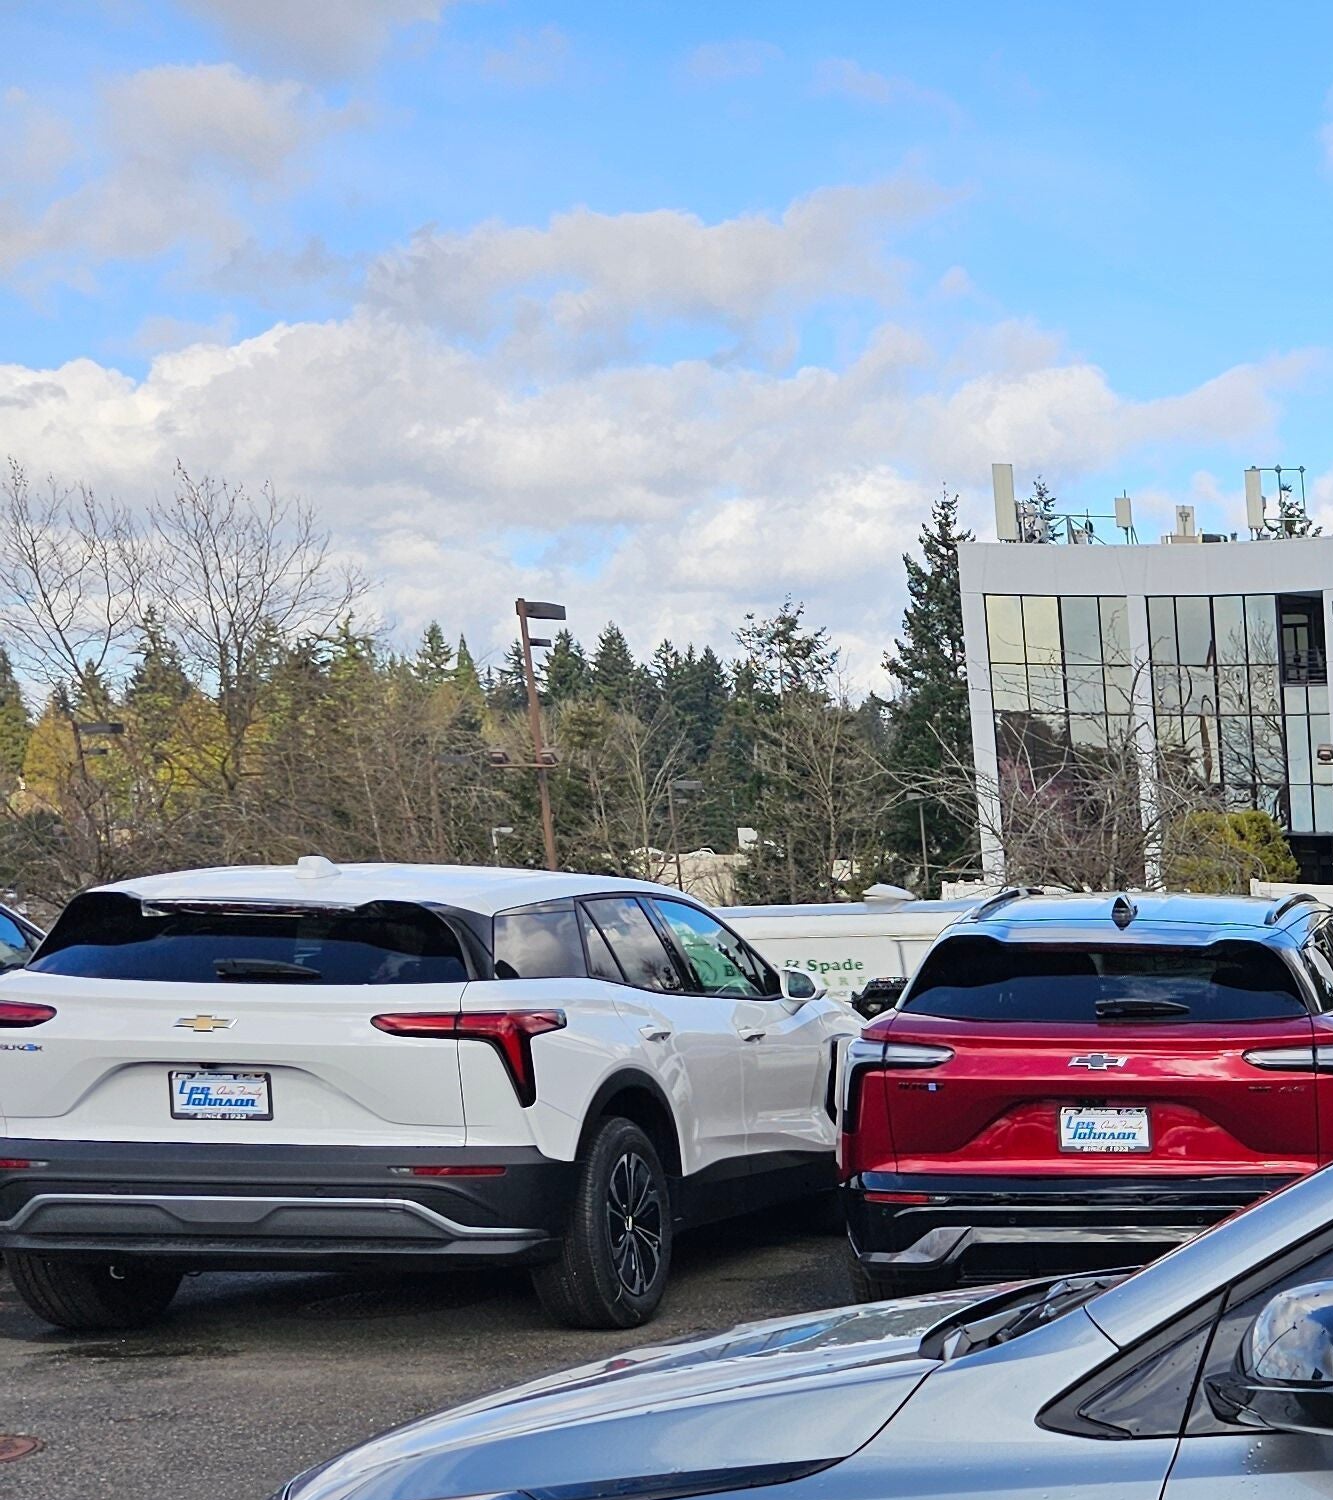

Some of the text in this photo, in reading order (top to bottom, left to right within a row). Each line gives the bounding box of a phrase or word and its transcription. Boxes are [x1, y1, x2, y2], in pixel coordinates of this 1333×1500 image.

[807, 958, 864, 974] Spade
[179, 1080, 212, 1095] Lee
[182, 1087, 257, 1107] Johnson
[1066, 1116, 1096, 1130] Lee
[1068, 1122, 1137, 1140] Johnson
